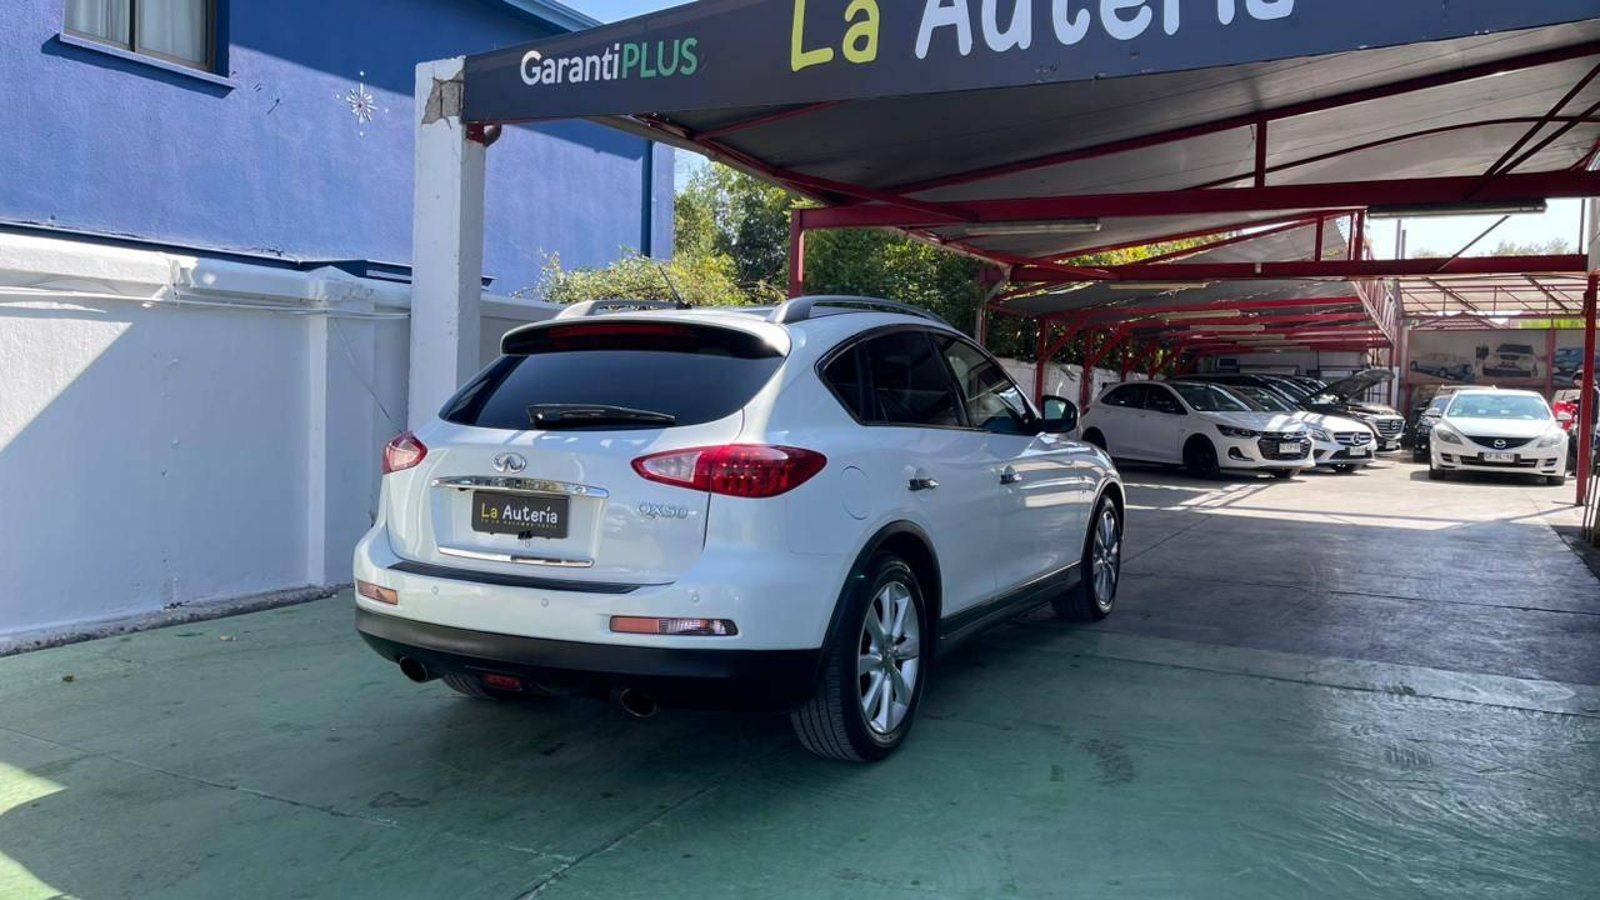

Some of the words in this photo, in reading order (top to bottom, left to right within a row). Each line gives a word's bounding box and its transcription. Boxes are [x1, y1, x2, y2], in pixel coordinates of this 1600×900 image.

[791, 0, 880, 71] La
[520, 38, 698, 86] GarantiPLUS
[481, 503, 498, 519] La
[502, 504, 558, 524] Autería
